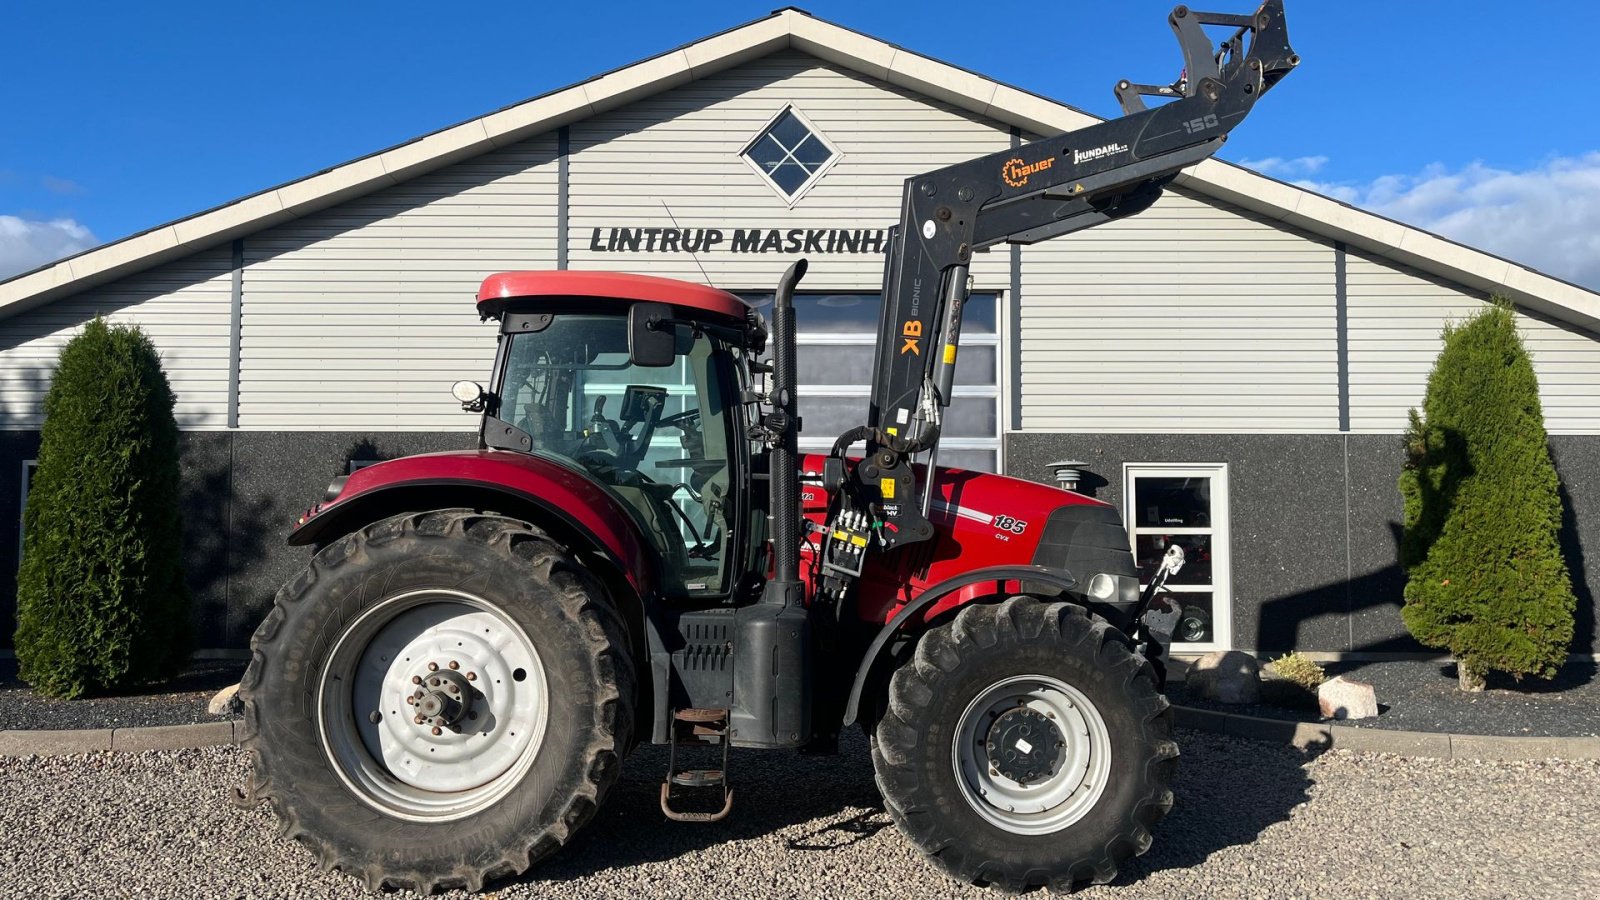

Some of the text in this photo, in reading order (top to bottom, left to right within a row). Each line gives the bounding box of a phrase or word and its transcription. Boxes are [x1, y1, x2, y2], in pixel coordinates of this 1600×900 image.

[1183, 113, 1219, 135] 150
[1011, 157, 1055, 179] hauer
[590, 227, 724, 253] LINTRUP
[911, 278, 922, 317] BIONIC
[994, 514, 1028, 535] 185
[995, 533, 1009, 542] CVX
